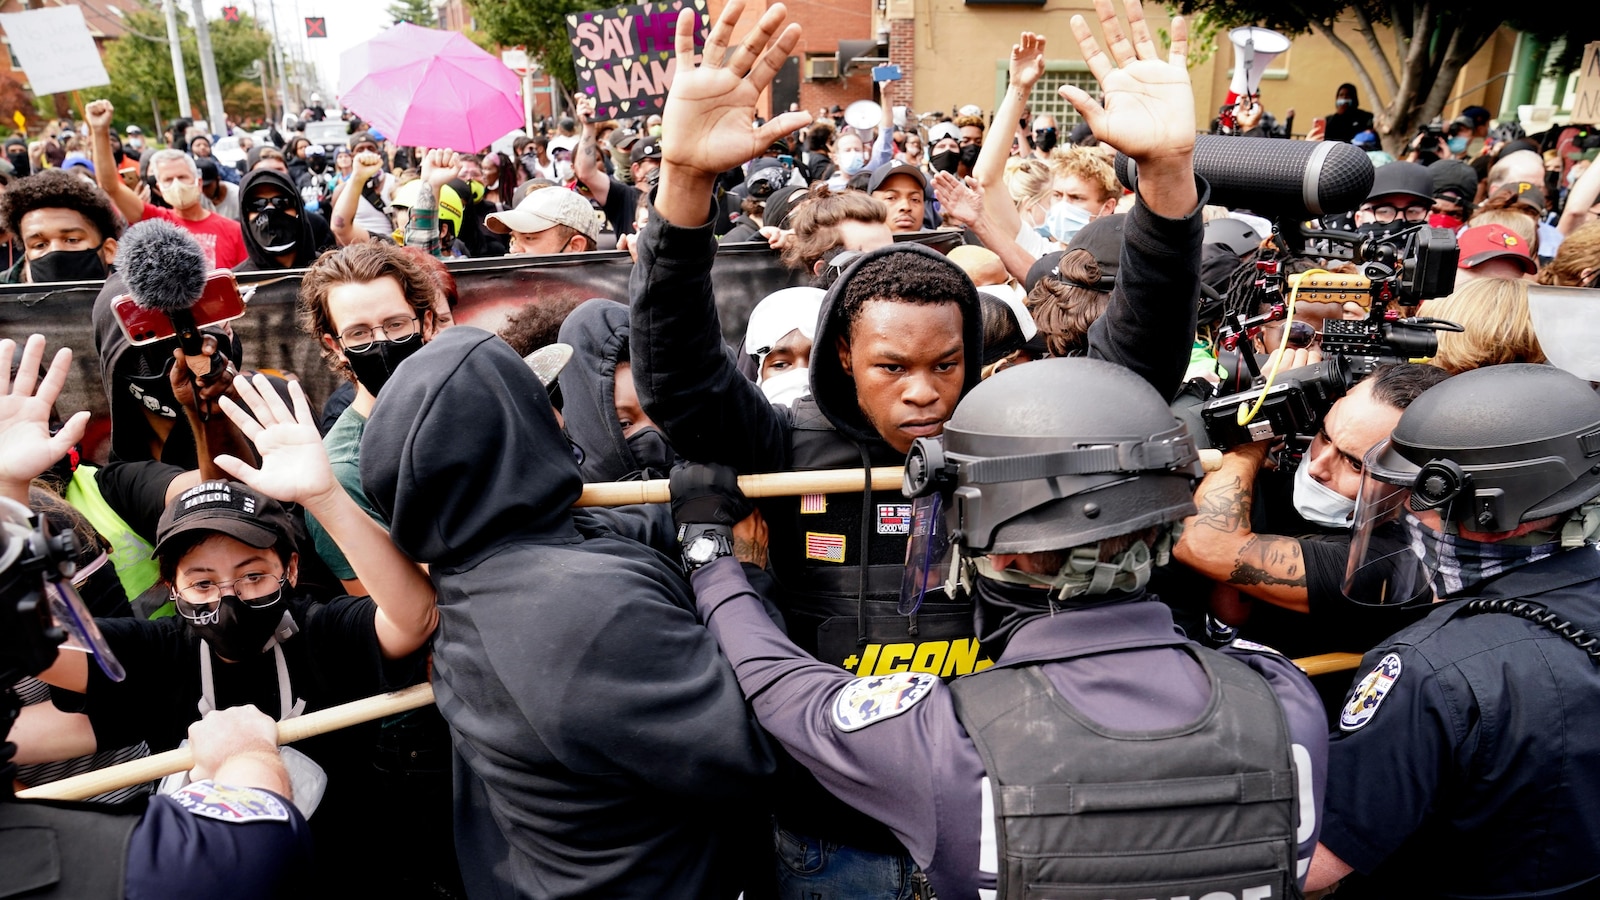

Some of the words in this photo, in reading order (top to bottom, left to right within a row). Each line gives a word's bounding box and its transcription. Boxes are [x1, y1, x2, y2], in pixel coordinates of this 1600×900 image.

[576, 15, 634, 60] SAY
[593, 54, 703, 103] NAM
[1518, 182, 1532, 195] P
[181, 483, 230, 501] BREONNA
[184, 493, 231, 510] TAYLOR
[243, 497, 255, 514] 502
[193, 610, 219, 625] LOU
